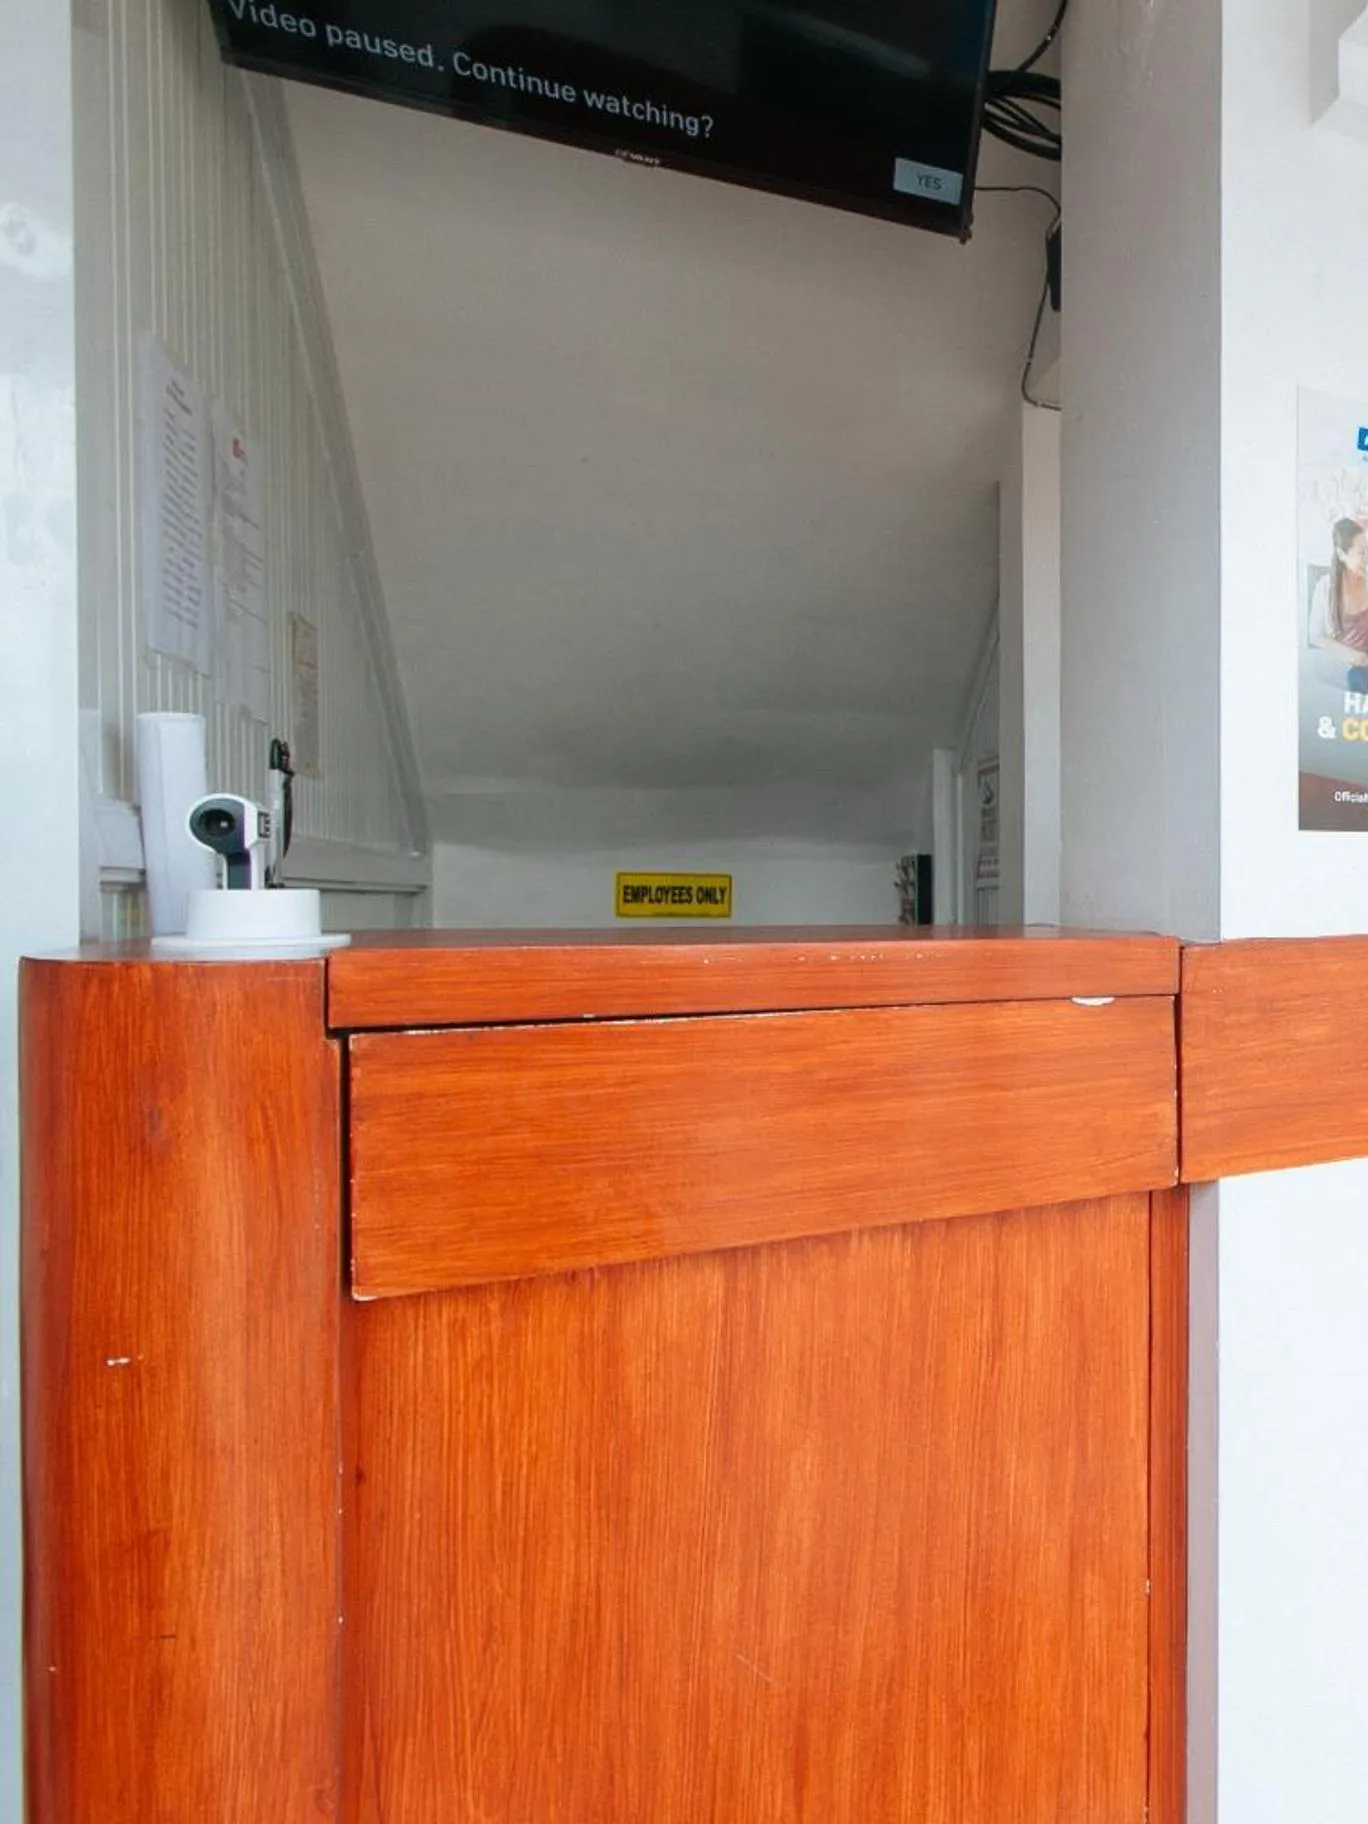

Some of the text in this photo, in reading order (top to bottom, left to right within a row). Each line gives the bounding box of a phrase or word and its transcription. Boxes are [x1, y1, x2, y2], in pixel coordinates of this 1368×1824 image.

[228, 0, 714, 138] Video paused. Continue watching?
[916, 172, 943, 192] YES
[1317, 716, 1337, 739] &
[623, 885, 727, 904] EMPLOYEES ONLY
